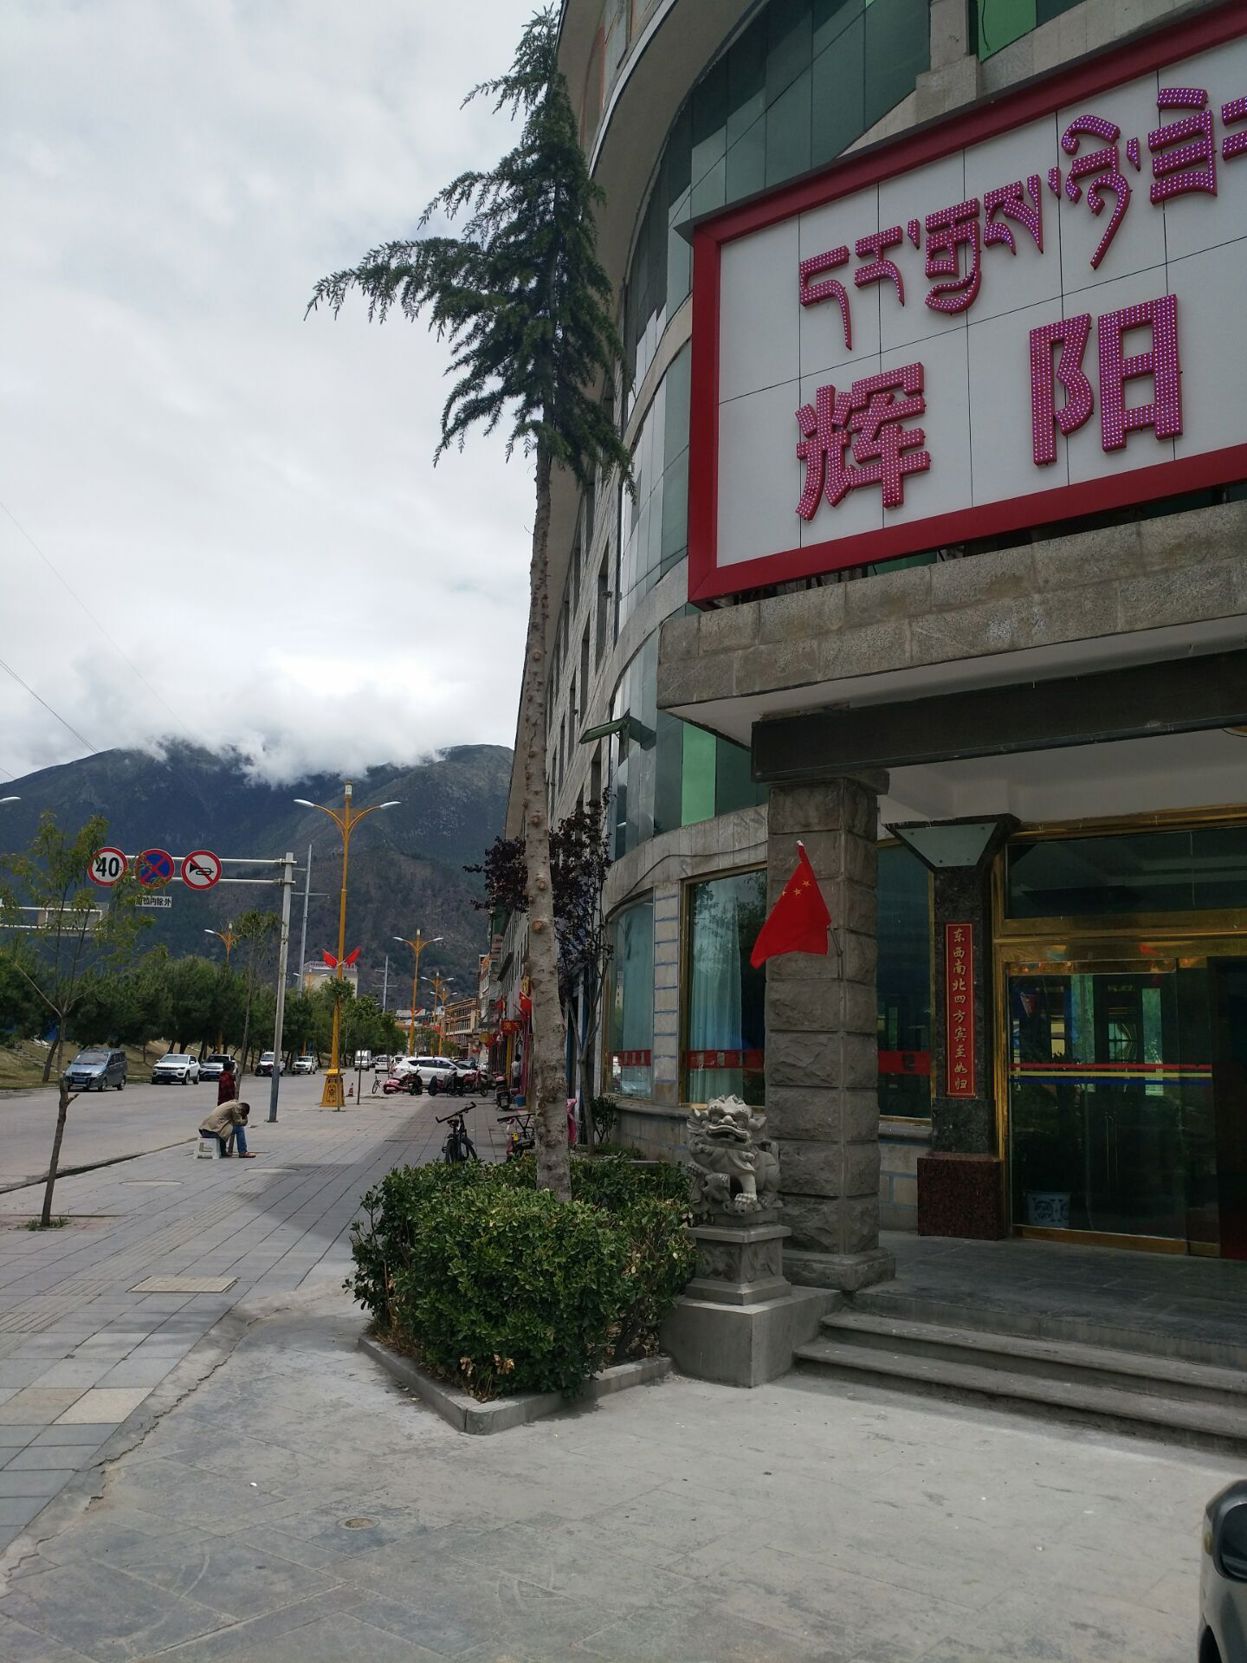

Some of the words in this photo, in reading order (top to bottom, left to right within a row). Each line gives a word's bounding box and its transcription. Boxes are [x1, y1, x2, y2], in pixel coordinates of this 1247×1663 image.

[796, 294, 1183, 521] 辉阳
[96, 857, 120, 877] 40
[953, 929, 968, 1090] 东西南北四方宾至如归
